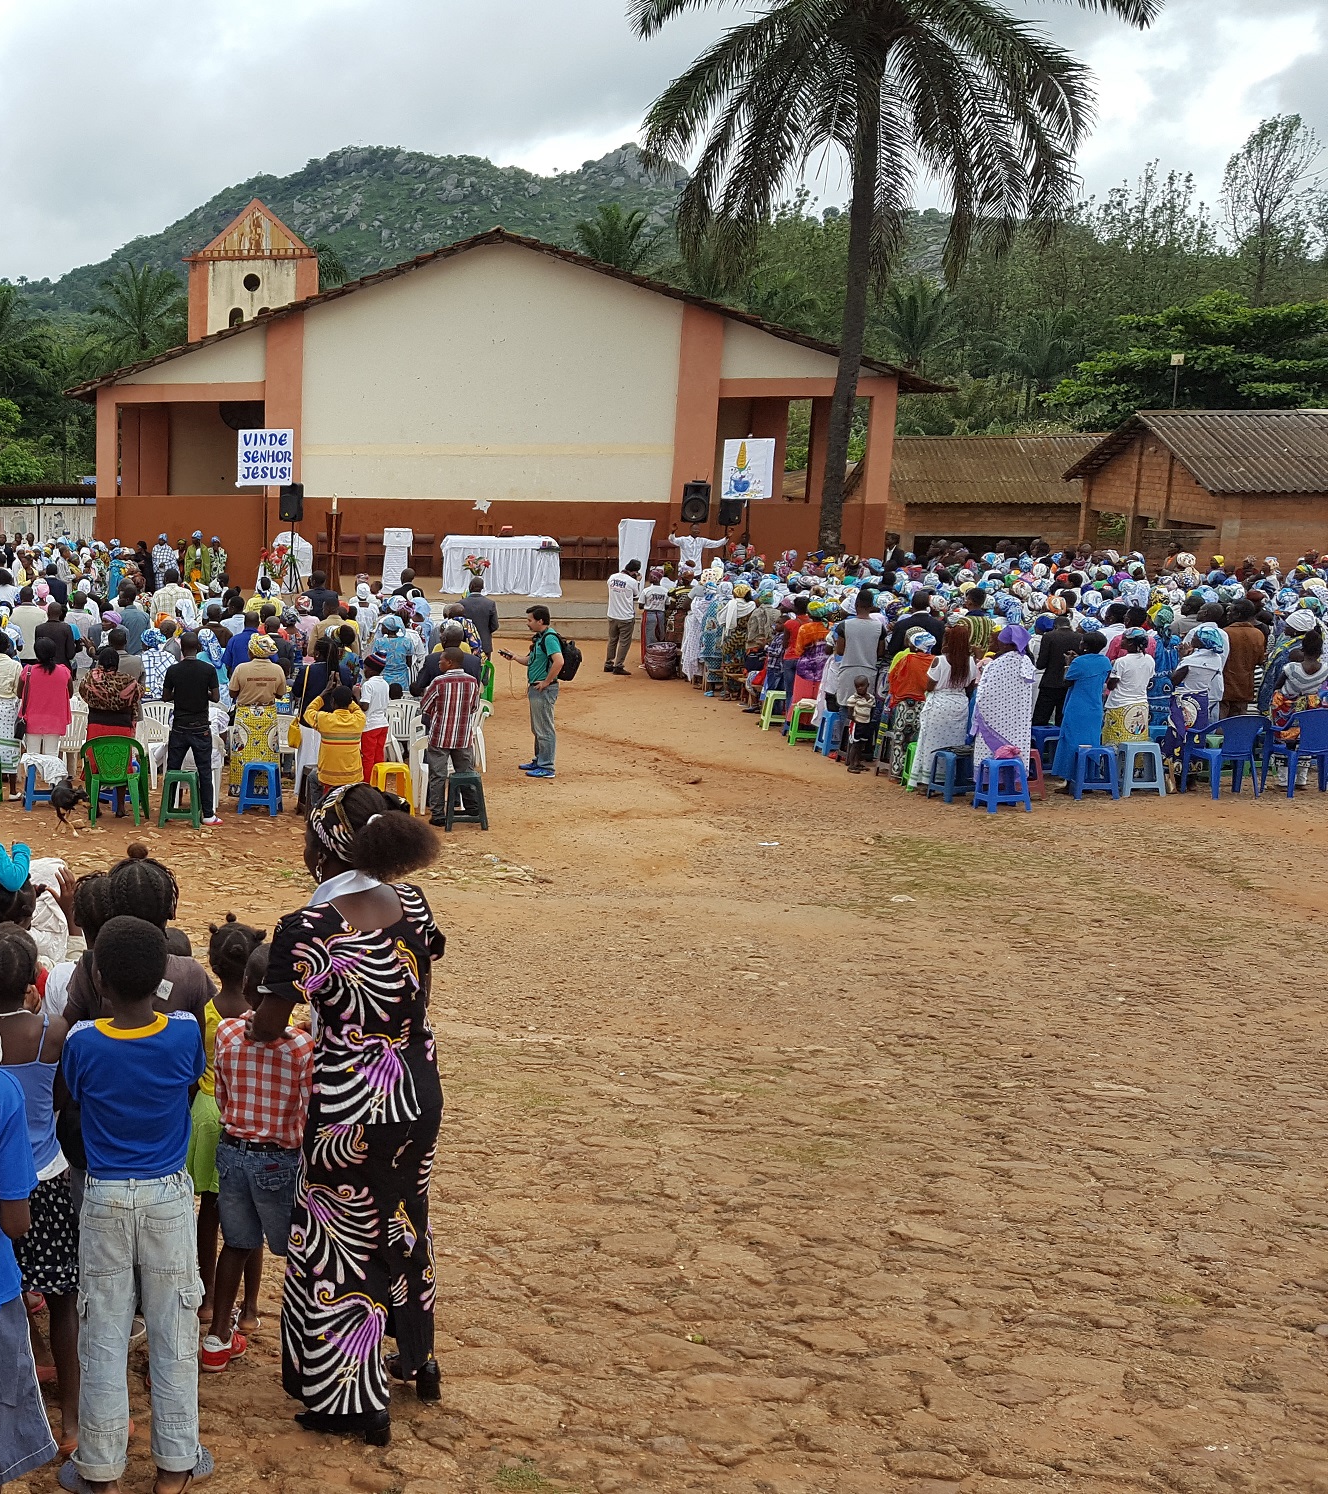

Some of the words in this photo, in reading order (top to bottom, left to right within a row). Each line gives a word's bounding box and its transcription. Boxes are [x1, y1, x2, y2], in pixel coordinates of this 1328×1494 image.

[243, 433, 288, 446] VINDE
[242, 450, 292, 463] SENHOR
[242, 466, 291, 481] JESUS!
